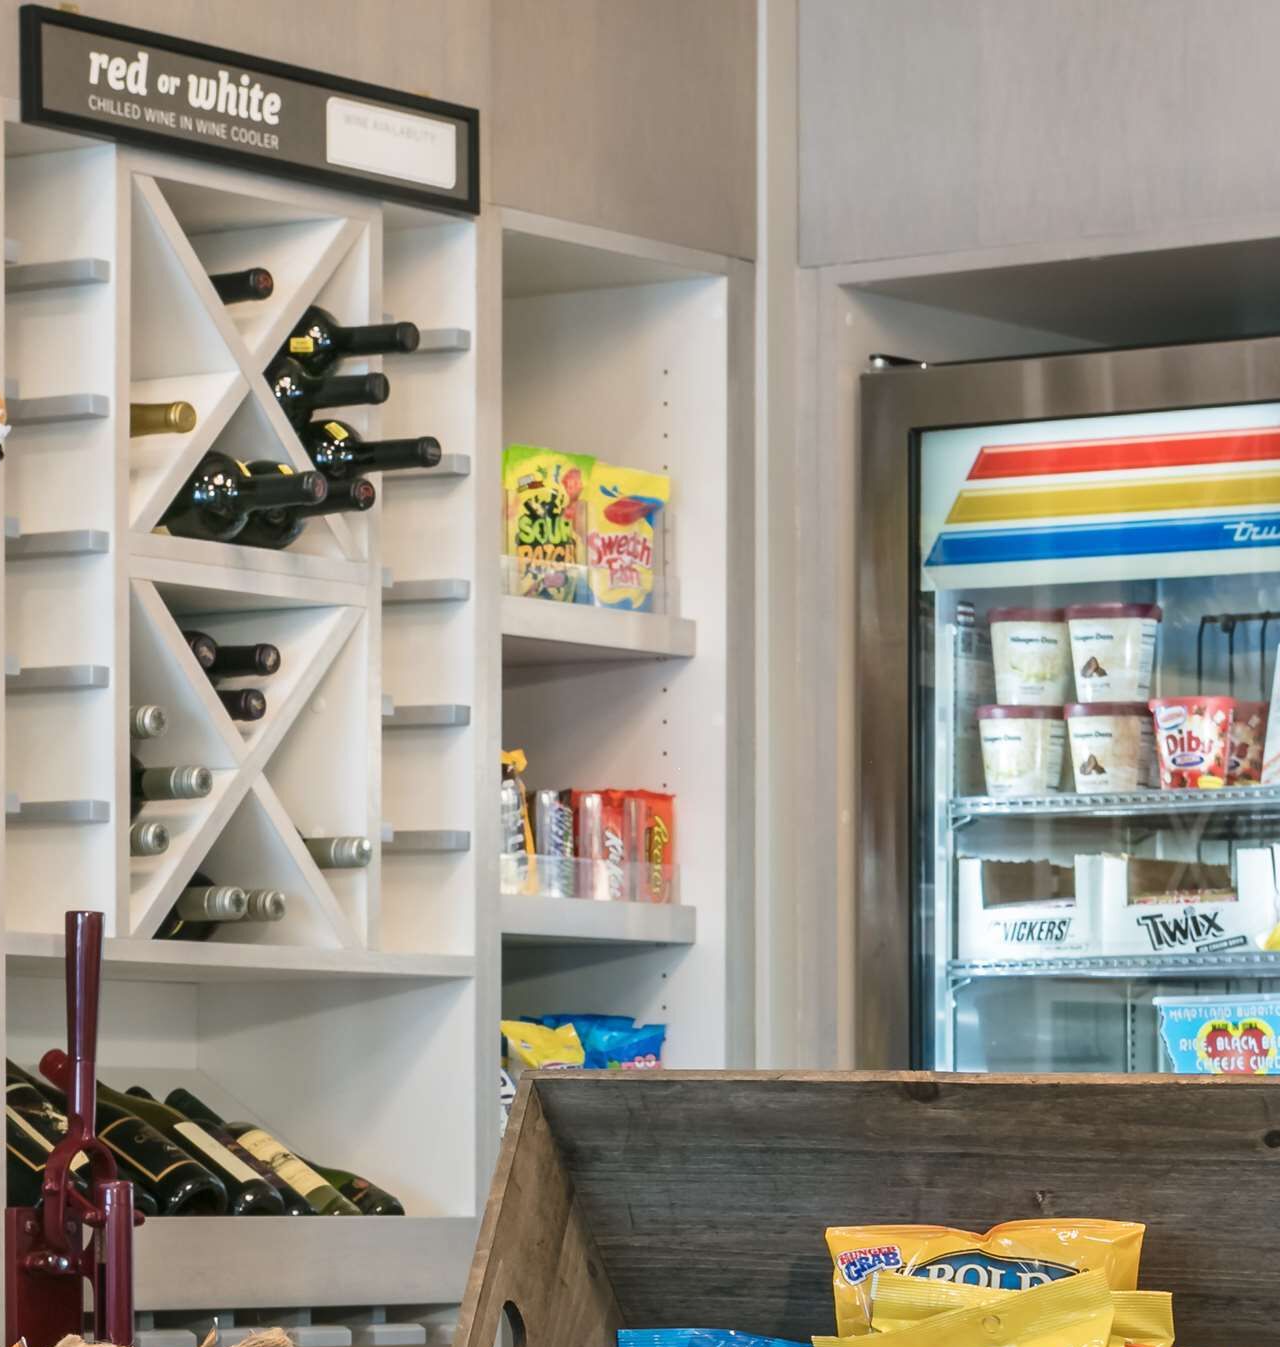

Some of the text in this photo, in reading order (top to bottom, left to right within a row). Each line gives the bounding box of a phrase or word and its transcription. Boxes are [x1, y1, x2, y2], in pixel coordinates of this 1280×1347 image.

[88, 51, 282, 126] red or white
[88, 95, 280, 150] CHILLED WINE IN WINE COOLER
[518, 514, 571, 544] SOUR
[1138, 905, 1225, 951] Twix
[1170, 1007, 1232, 1022] HEARTLAND
[1180, 1038, 1212, 1052] RICE,
[1216, 1036, 1259, 1053] BLACK
[1196, 1056, 1245, 1071] CHEESE
[844, 1251, 901, 1284] GRAB
